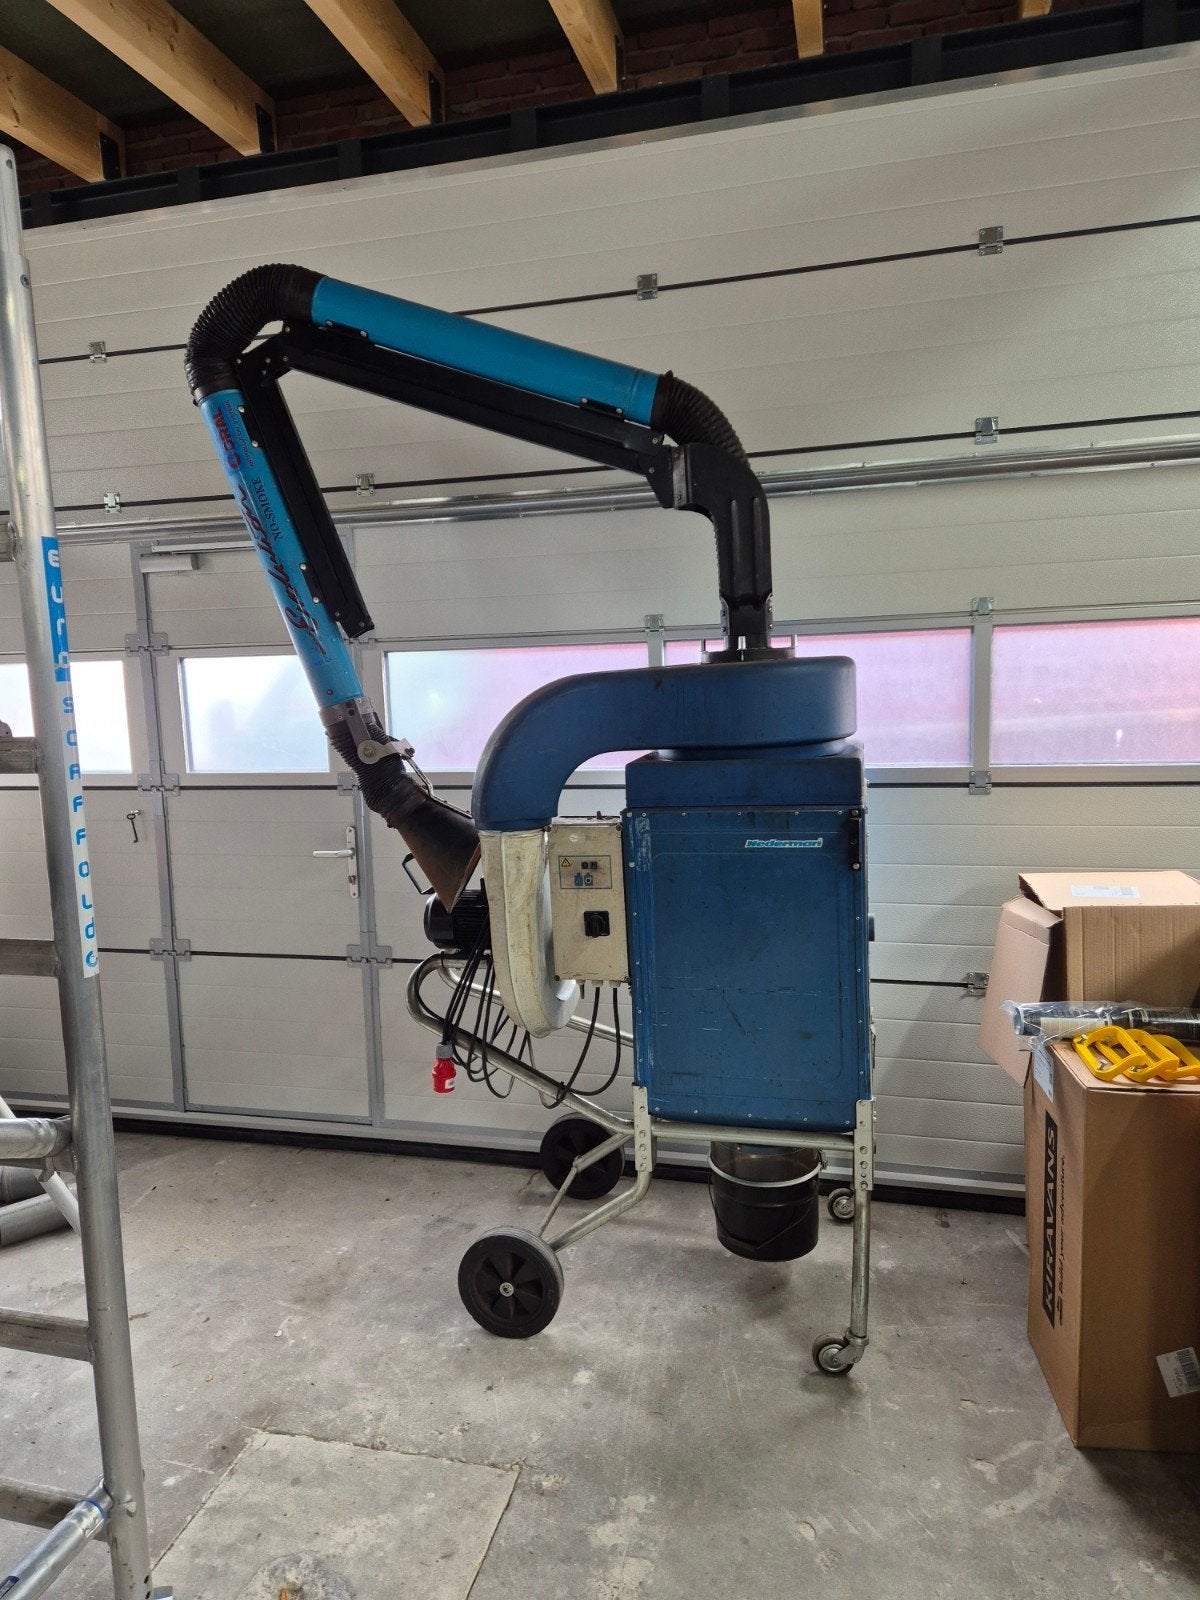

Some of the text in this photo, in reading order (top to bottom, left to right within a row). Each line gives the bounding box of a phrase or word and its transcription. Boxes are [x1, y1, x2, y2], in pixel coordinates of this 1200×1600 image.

[211, 406, 241, 470] CORAL
[251, 475, 283, 541] NO-SMOKE
[745, 837, 823, 849] Nederman
[1045, 1126, 1055, 1313] KIRAVANS
